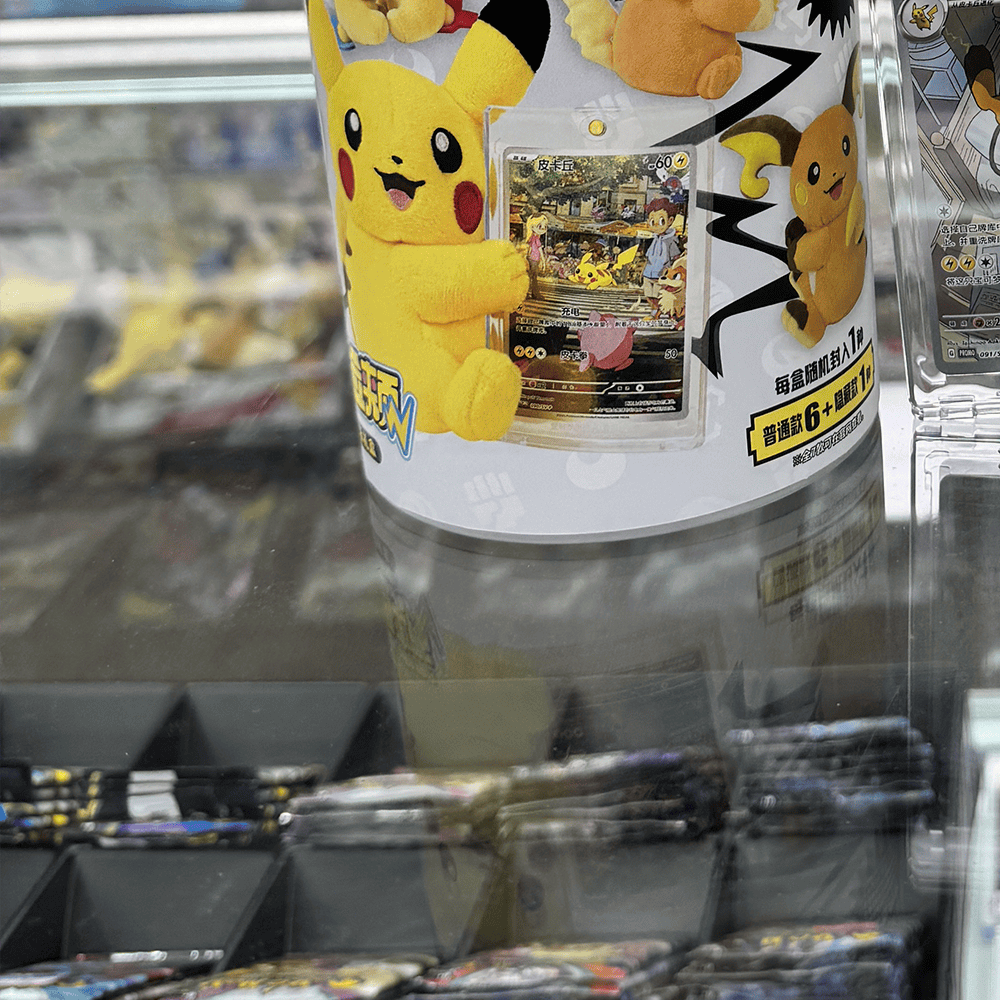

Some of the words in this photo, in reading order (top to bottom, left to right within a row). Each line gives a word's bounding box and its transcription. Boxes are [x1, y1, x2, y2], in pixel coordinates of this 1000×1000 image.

[538, 159, 574, 172] 皮卡丘
[656, 155, 672, 169] 60
[561, 307, 580, 316] 充电
[664, 348, 678, 359] 50
[775, 325, 864, 395] 每盒随机封入1种
